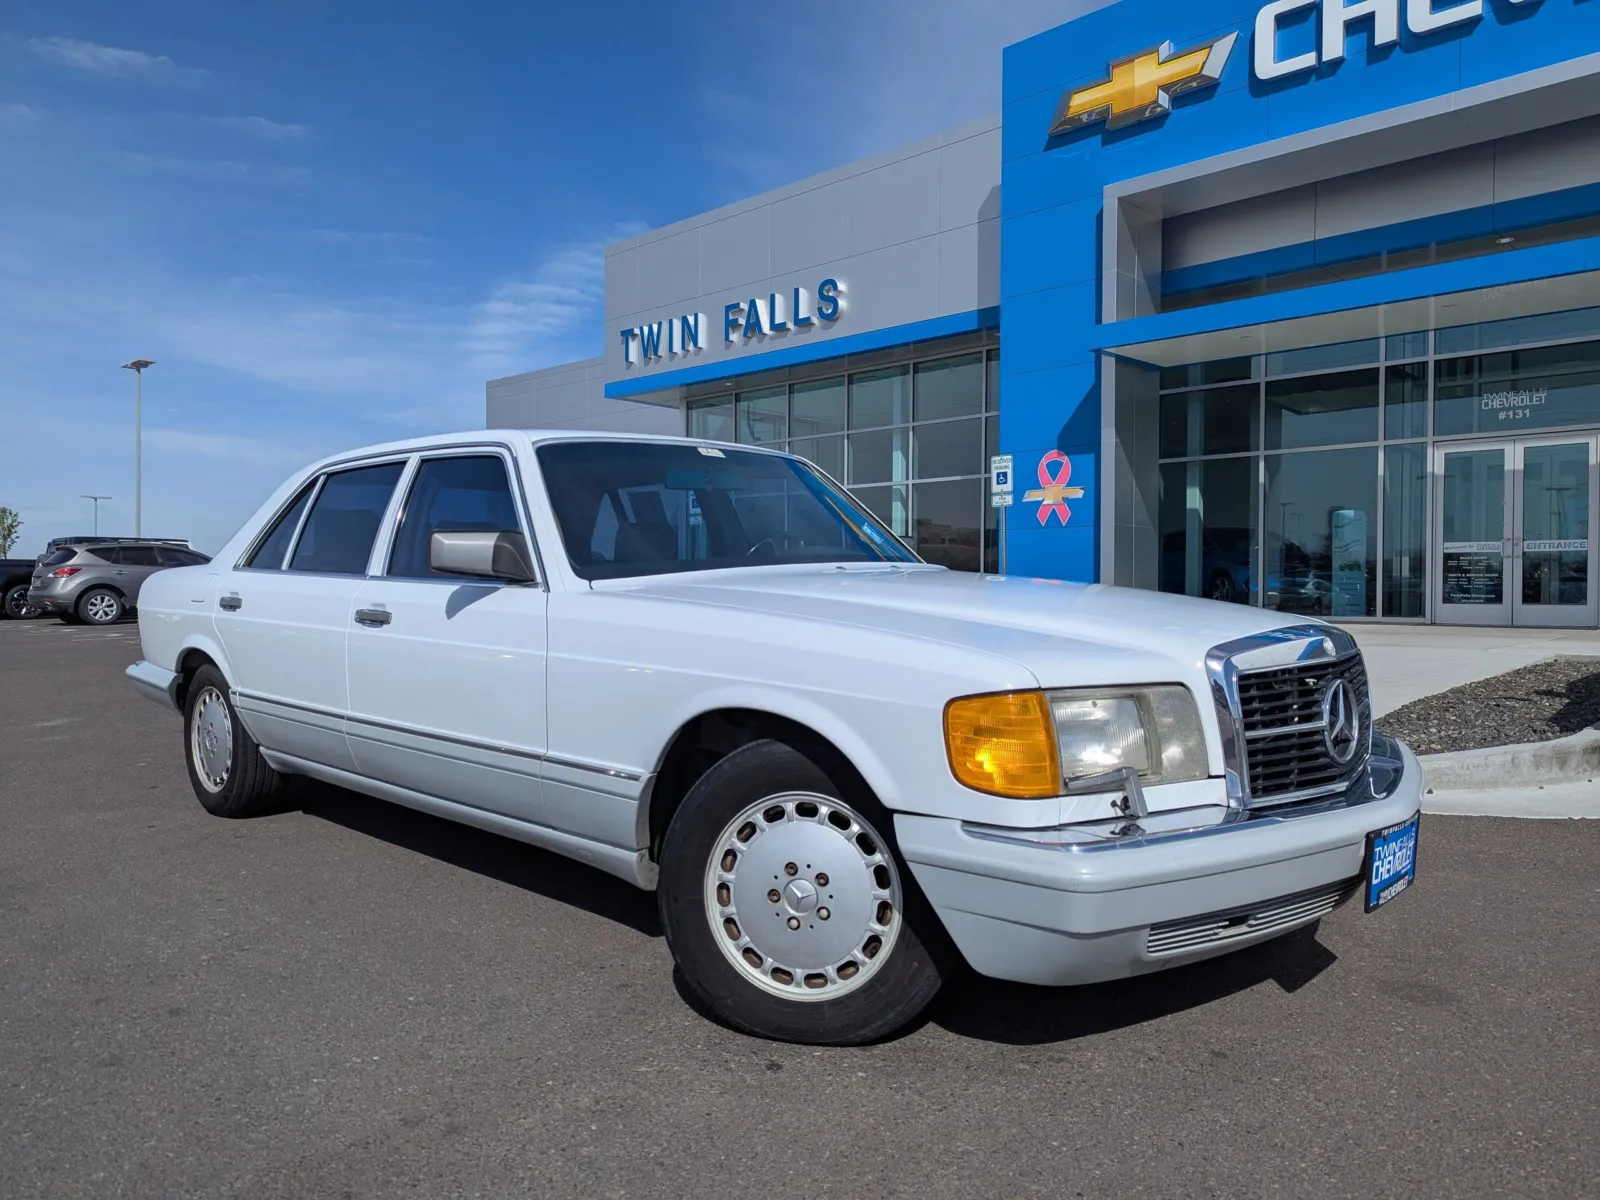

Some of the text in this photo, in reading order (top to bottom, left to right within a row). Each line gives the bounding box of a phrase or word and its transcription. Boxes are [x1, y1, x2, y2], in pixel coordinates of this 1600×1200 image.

[620, 279, 845, 363] TWIN FALLS
[1482, 394, 1547, 409] CHEVROLET
[1498, 409, 1530, 420] #131
[1526, 542, 1587, 550] ENTRANCE
[1372, 842, 1415, 885] CHEVROLET
